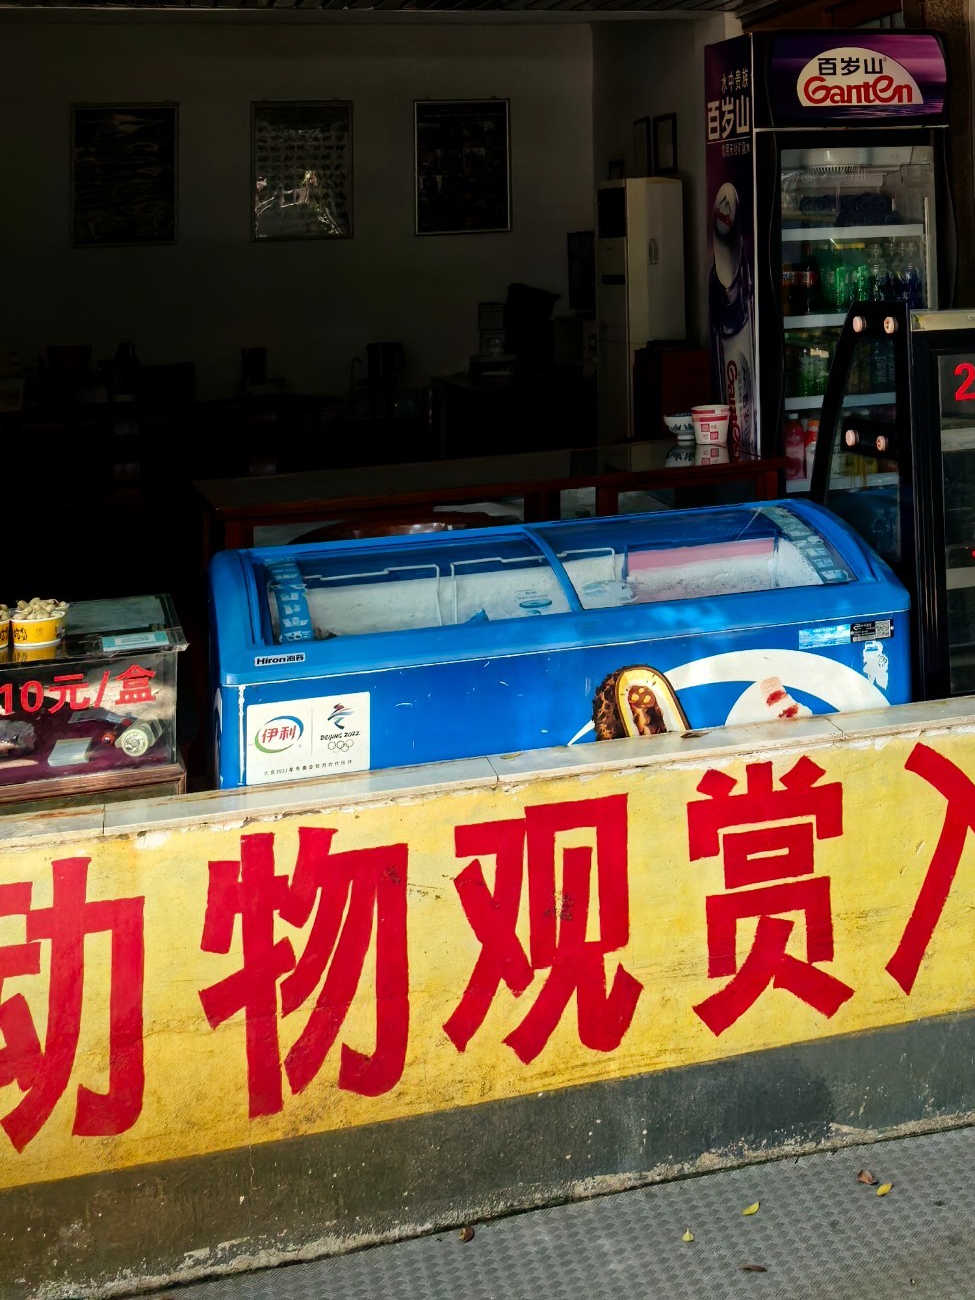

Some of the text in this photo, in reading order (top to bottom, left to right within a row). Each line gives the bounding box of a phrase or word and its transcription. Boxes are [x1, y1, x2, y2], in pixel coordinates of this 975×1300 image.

[817, 57, 883, 76] 百岁山
[721, 67, 749, 92] 水中贵族
[803, 75, 913, 105] Ganten
[707, 95, 750, 141] 百岁山
[0, 664, 157, 715] 10元/盒
[262, 725, 297, 743] 伊利
[320, 733, 342, 741] BEIJING
